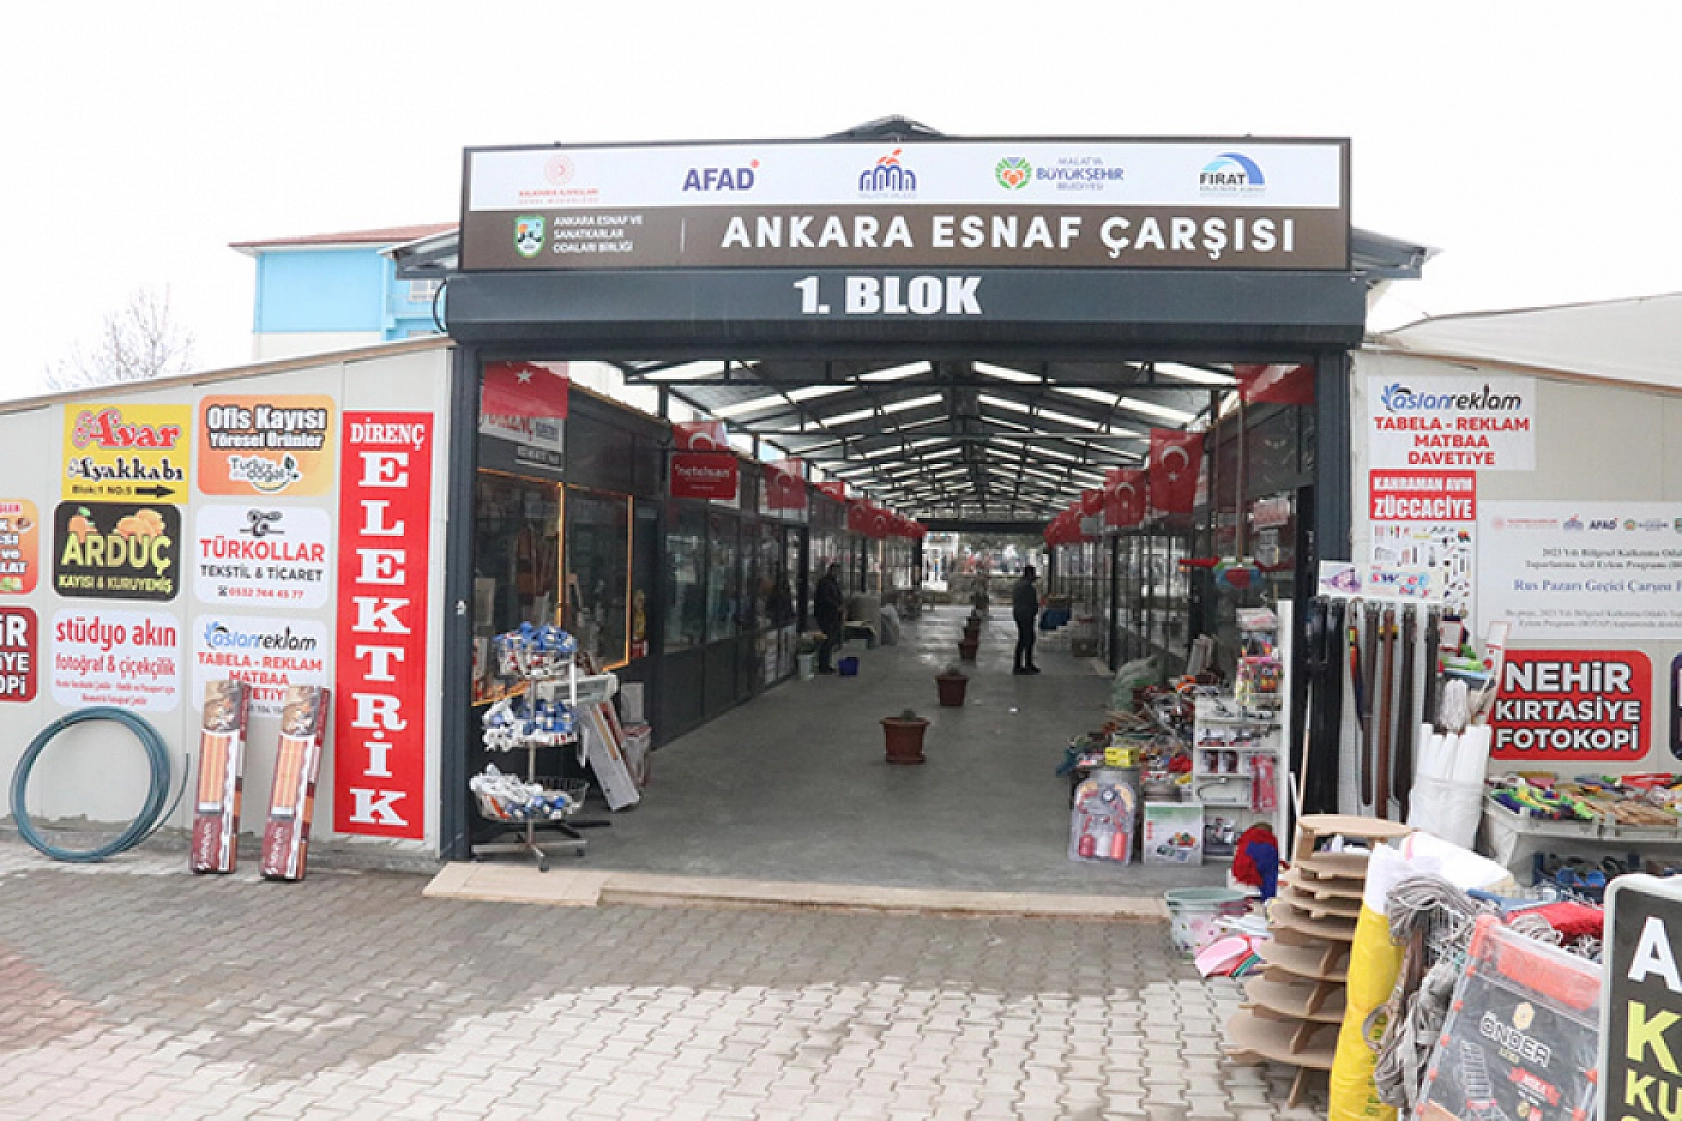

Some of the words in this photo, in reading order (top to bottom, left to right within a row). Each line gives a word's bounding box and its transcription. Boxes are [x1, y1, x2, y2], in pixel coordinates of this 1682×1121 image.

[682, 167, 755, 192] AFAD
[1200, 173, 1246, 185] FIRAT
[721, 216, 914, 249] ANKARA
[932, 216, 1082, 248] ESNAF
[1101, 216, 1295, 260] ÇARŞISI
[794, 277, 831, 314] 1.
[846, 276, 982, 315] BLOK
[1394, 383, 1522, 411] aslanreklam
[73, 409, 181, 448] Avar
[207, 404, 251, 430] Ofis
[254, 404, 326, 433] Kayısı
[1374, 416, 1442, 430] TABELA
[1457, 417, 1530, 430] REKLAM
[210, 432, 265, 448] Yöresel
[266, 431, 325, 448] Ürünler
[350, 417, 425, 451] DİRENÇ
[1415, 434, 1489, 448] MATBAA
[68, 457, 184, 481] Ayakkabı
[1408, 451, 1495, 464] DAVETİYE
[1374, 477, 1442, 491] KAHRAMAN
[1374, 494, 1472, 518] ZÜCCACİYE
[61, 534, 172, 575] ARDUÇ
[200, 536, 325, 562] TÜRKOLLAR
[201, 565, 251, 579] TEKSTİL
[255, 567, 262, 579] &
[268, 566, 323, 582] TİCARET
[55, 616, 126, 651] stüdyo
[132, 618, 176, 646] akın
[211, 626, 317, 650] aslanreklam
[349, 452, 411, 826] ELEKTRİK
[55, 652, 104, 675] fotoğraf
[107, 654, 115, 673] &
[119, 656, 175, 680] çiçekçilik
[198, 652, 250, 667] TABELA
[262, 657, 322, 671] REKLAM
[228, 670, 289, 685] MATBAA
[1504, 662, 1631, 693] NEHİR
[1495, 696, 1640, 721] KIRTASİYE
[1496, 724, 1638, 749] FOTOKOPİ
